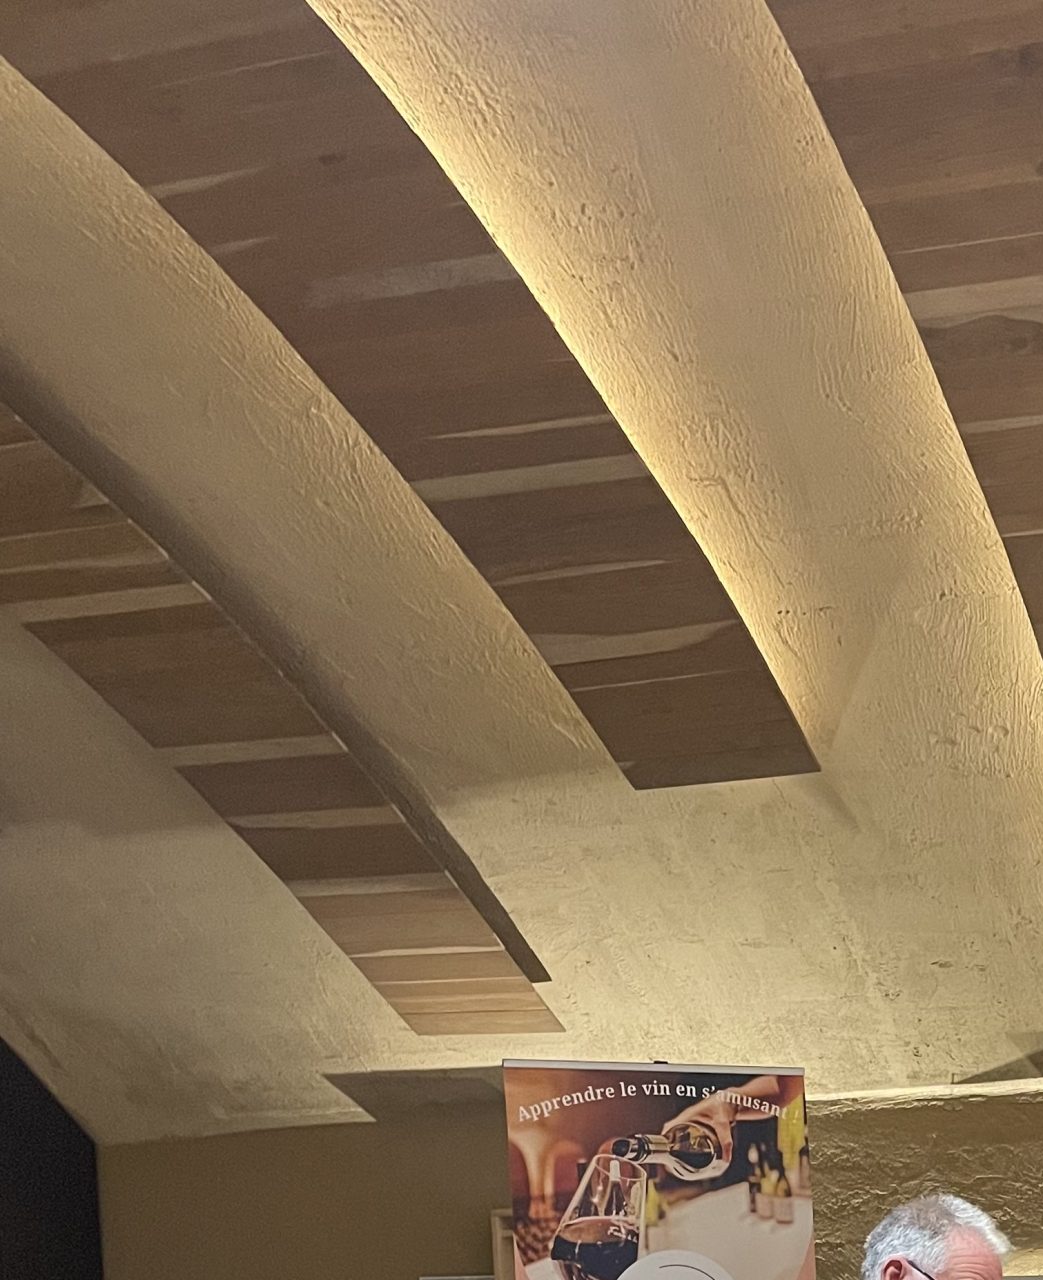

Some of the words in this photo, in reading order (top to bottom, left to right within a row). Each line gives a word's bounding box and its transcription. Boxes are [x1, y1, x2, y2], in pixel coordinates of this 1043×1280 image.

[518, 1085, 615, 1122] Apprendre
[619, 1081, 637, 1097] le
[642, 1080, 671, 1096] vin
[675, 1083, 697, 1098] en
